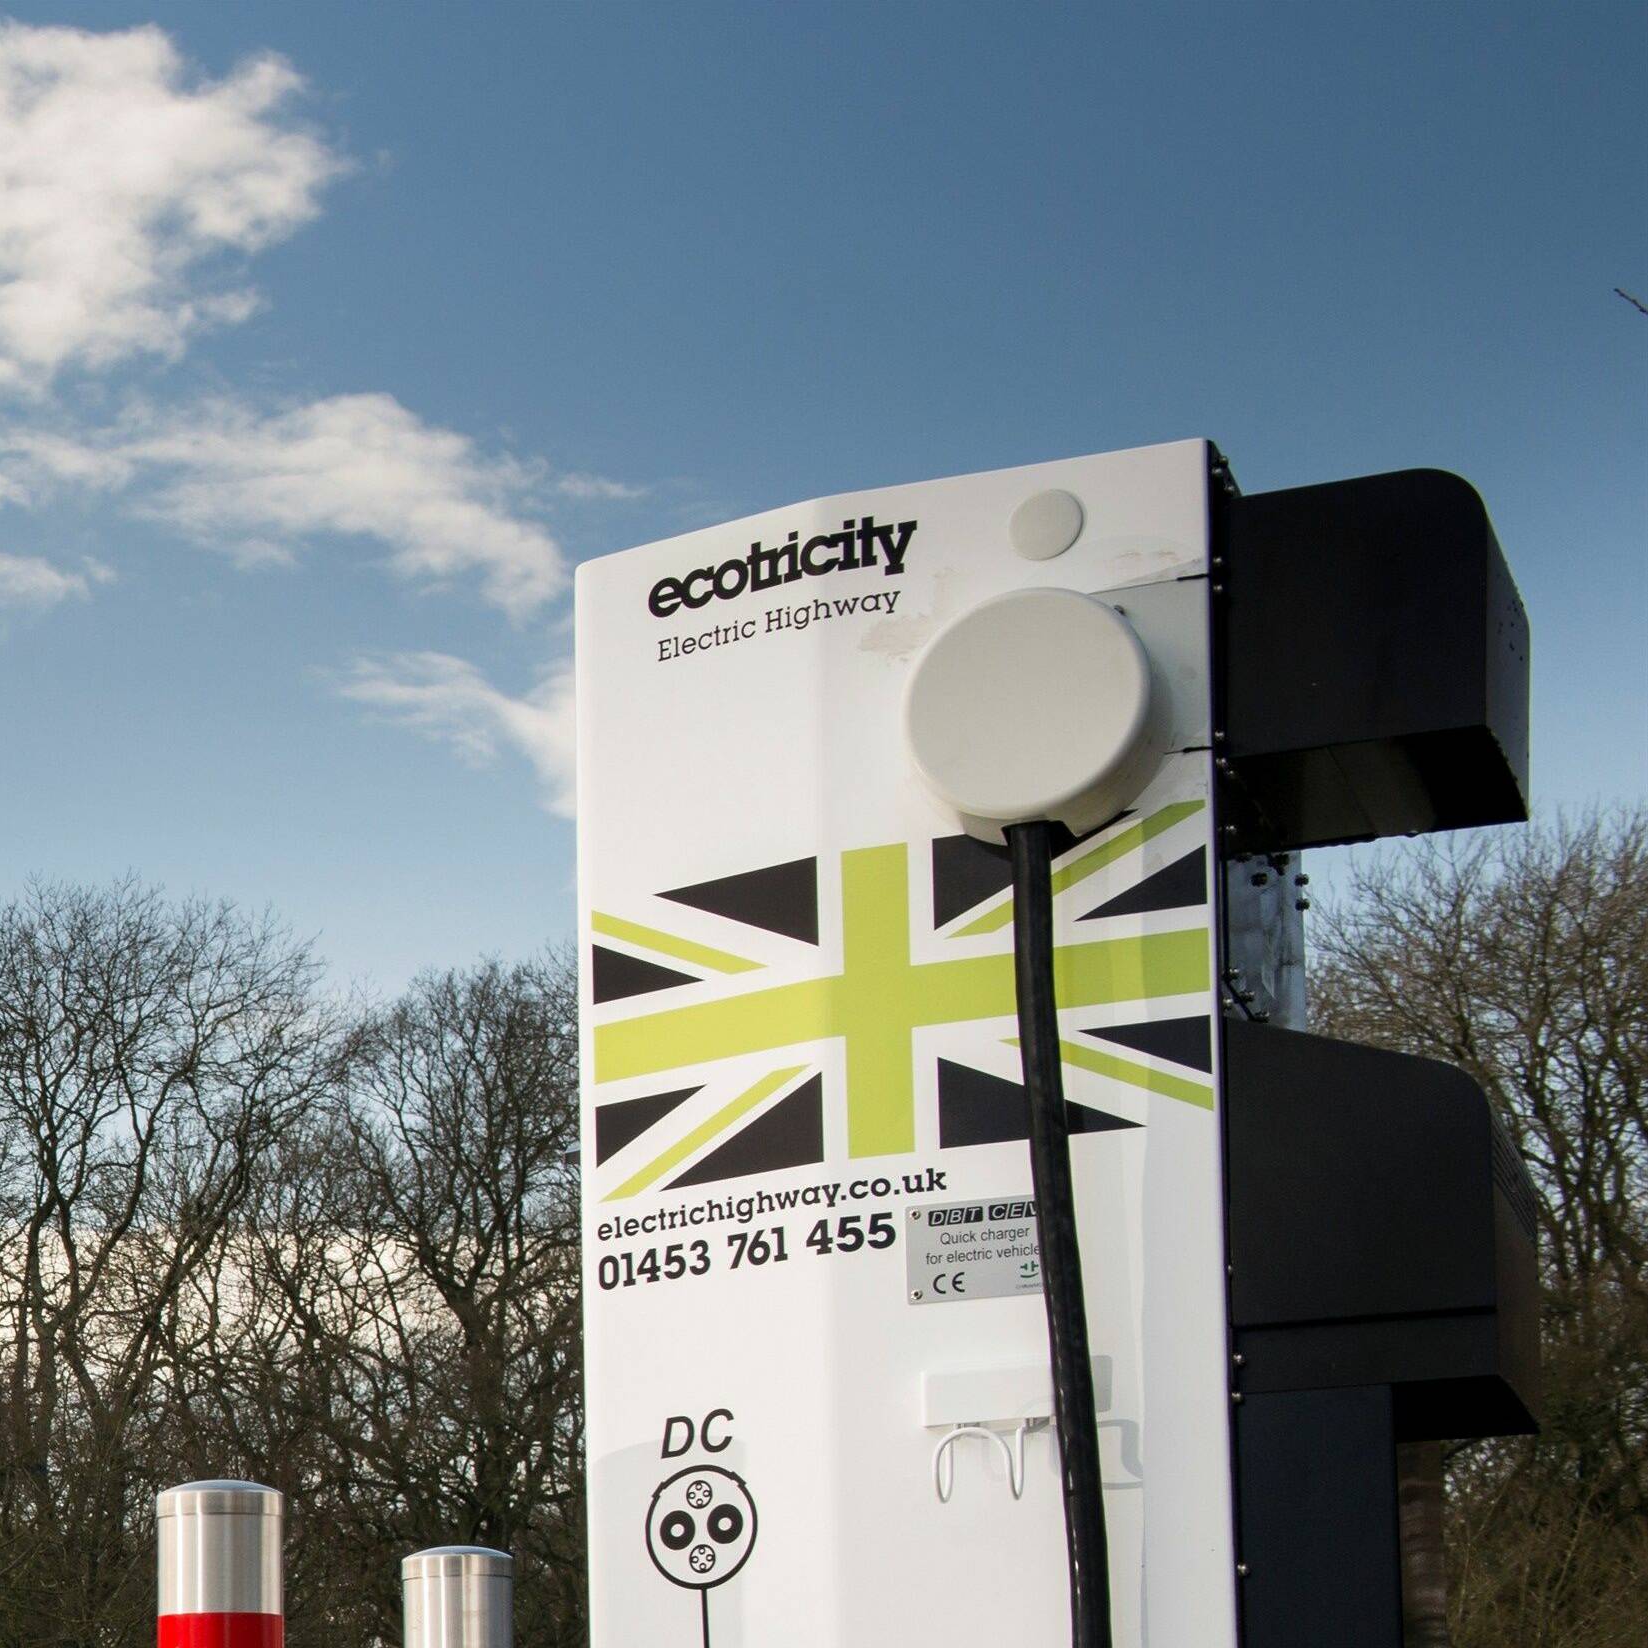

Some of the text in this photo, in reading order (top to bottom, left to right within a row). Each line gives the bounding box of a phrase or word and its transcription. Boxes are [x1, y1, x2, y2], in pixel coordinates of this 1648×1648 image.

[649, 516, 918, 618] ecotricity
[658, 590, 901, 662] Electric Highway
[597, 1168, 947, 1241] electrichighway.co.uk
[928, 1206, 983, 1227] DBT
[598, 1211, 896, 1291] 01453 761 455
[926, 1253, 943, 1265] for
[946, 1248, 992, 1263] electric
[940, 1228, 1030, 1245] Quick charger
[661, 1408, 734, 1459] DC
